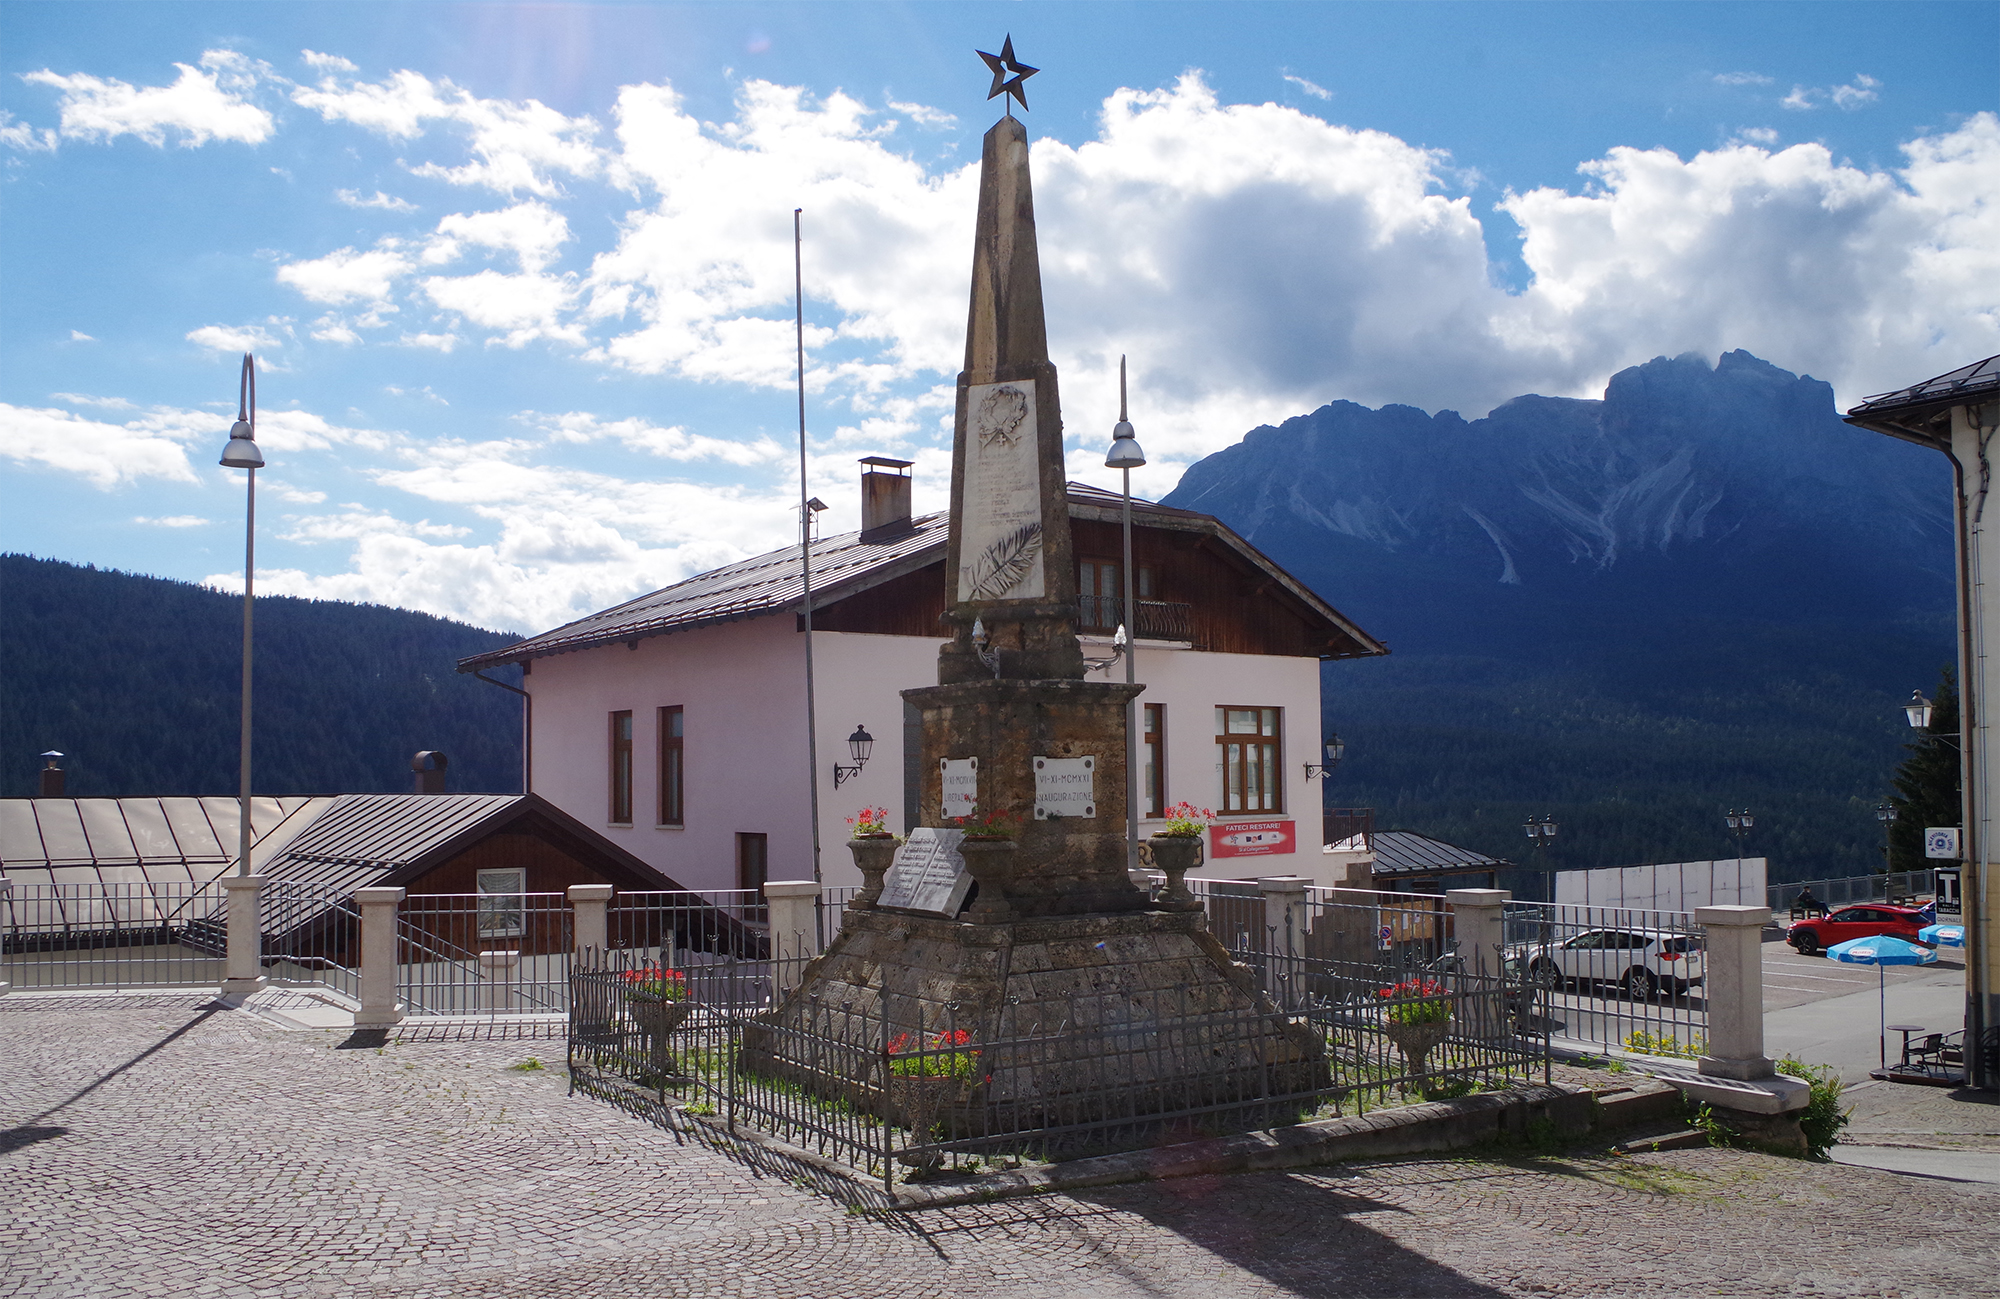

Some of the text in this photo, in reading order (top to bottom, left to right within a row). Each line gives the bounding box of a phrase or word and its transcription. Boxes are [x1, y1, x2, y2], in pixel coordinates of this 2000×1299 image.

[1039, 774, 1090, 784] VI-XI-MCMXXI
[1036, 792, 1093, 802] INAUGURAZIONE
[1939, 874, 1957, 903] T
